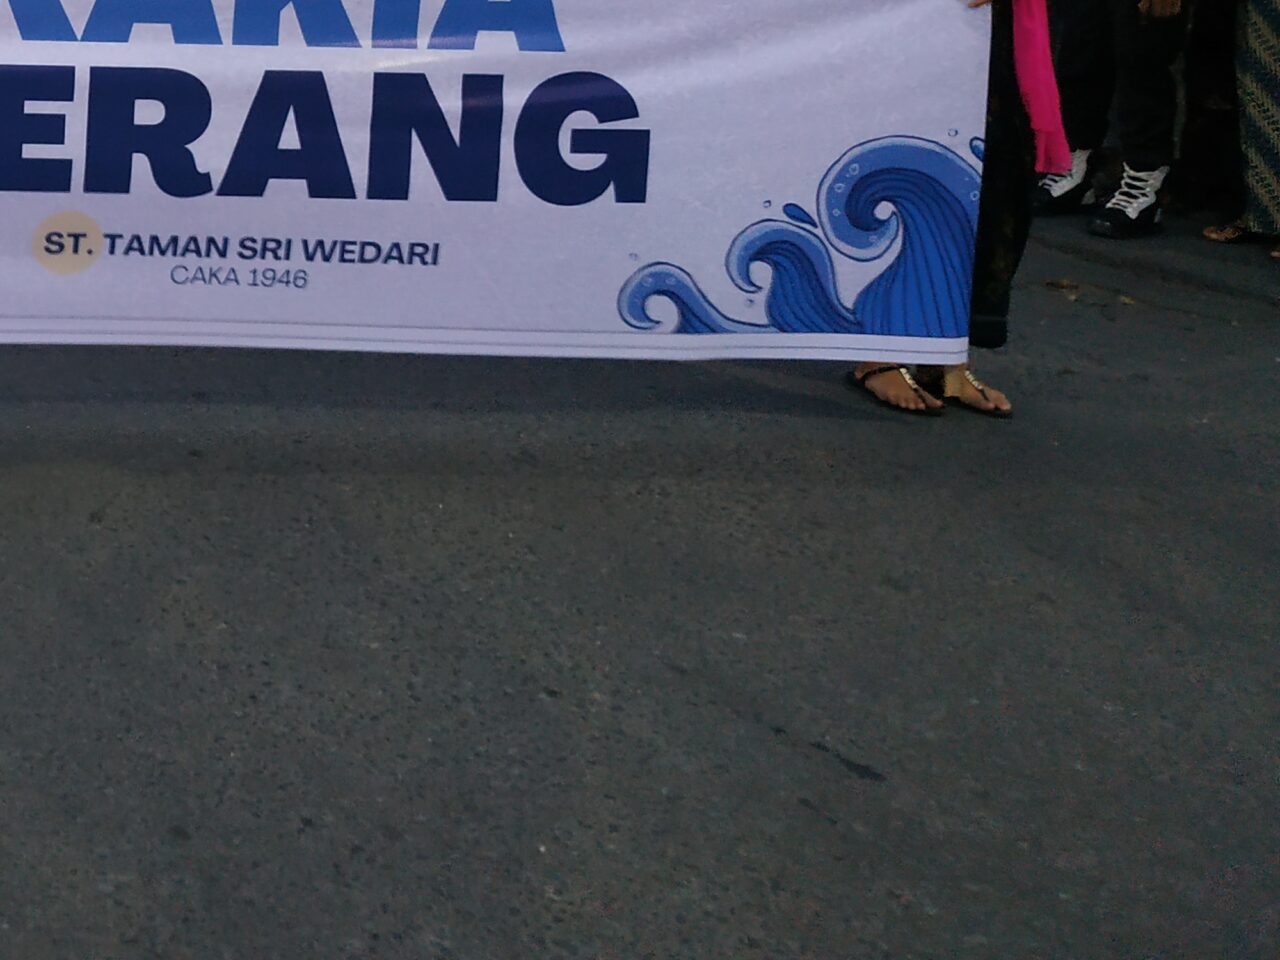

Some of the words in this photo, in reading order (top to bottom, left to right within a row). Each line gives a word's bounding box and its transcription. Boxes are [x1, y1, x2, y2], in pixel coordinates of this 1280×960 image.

[43, 231, 94, 256] ST.
[104, 233, 229, 258] TAMAN
[237, 236, 292, 261] SRI
[301, 238, 441, 266] WEDARI
[170, 264, 240, 286] CAKA
[248, 267, 308, 289] 1946
